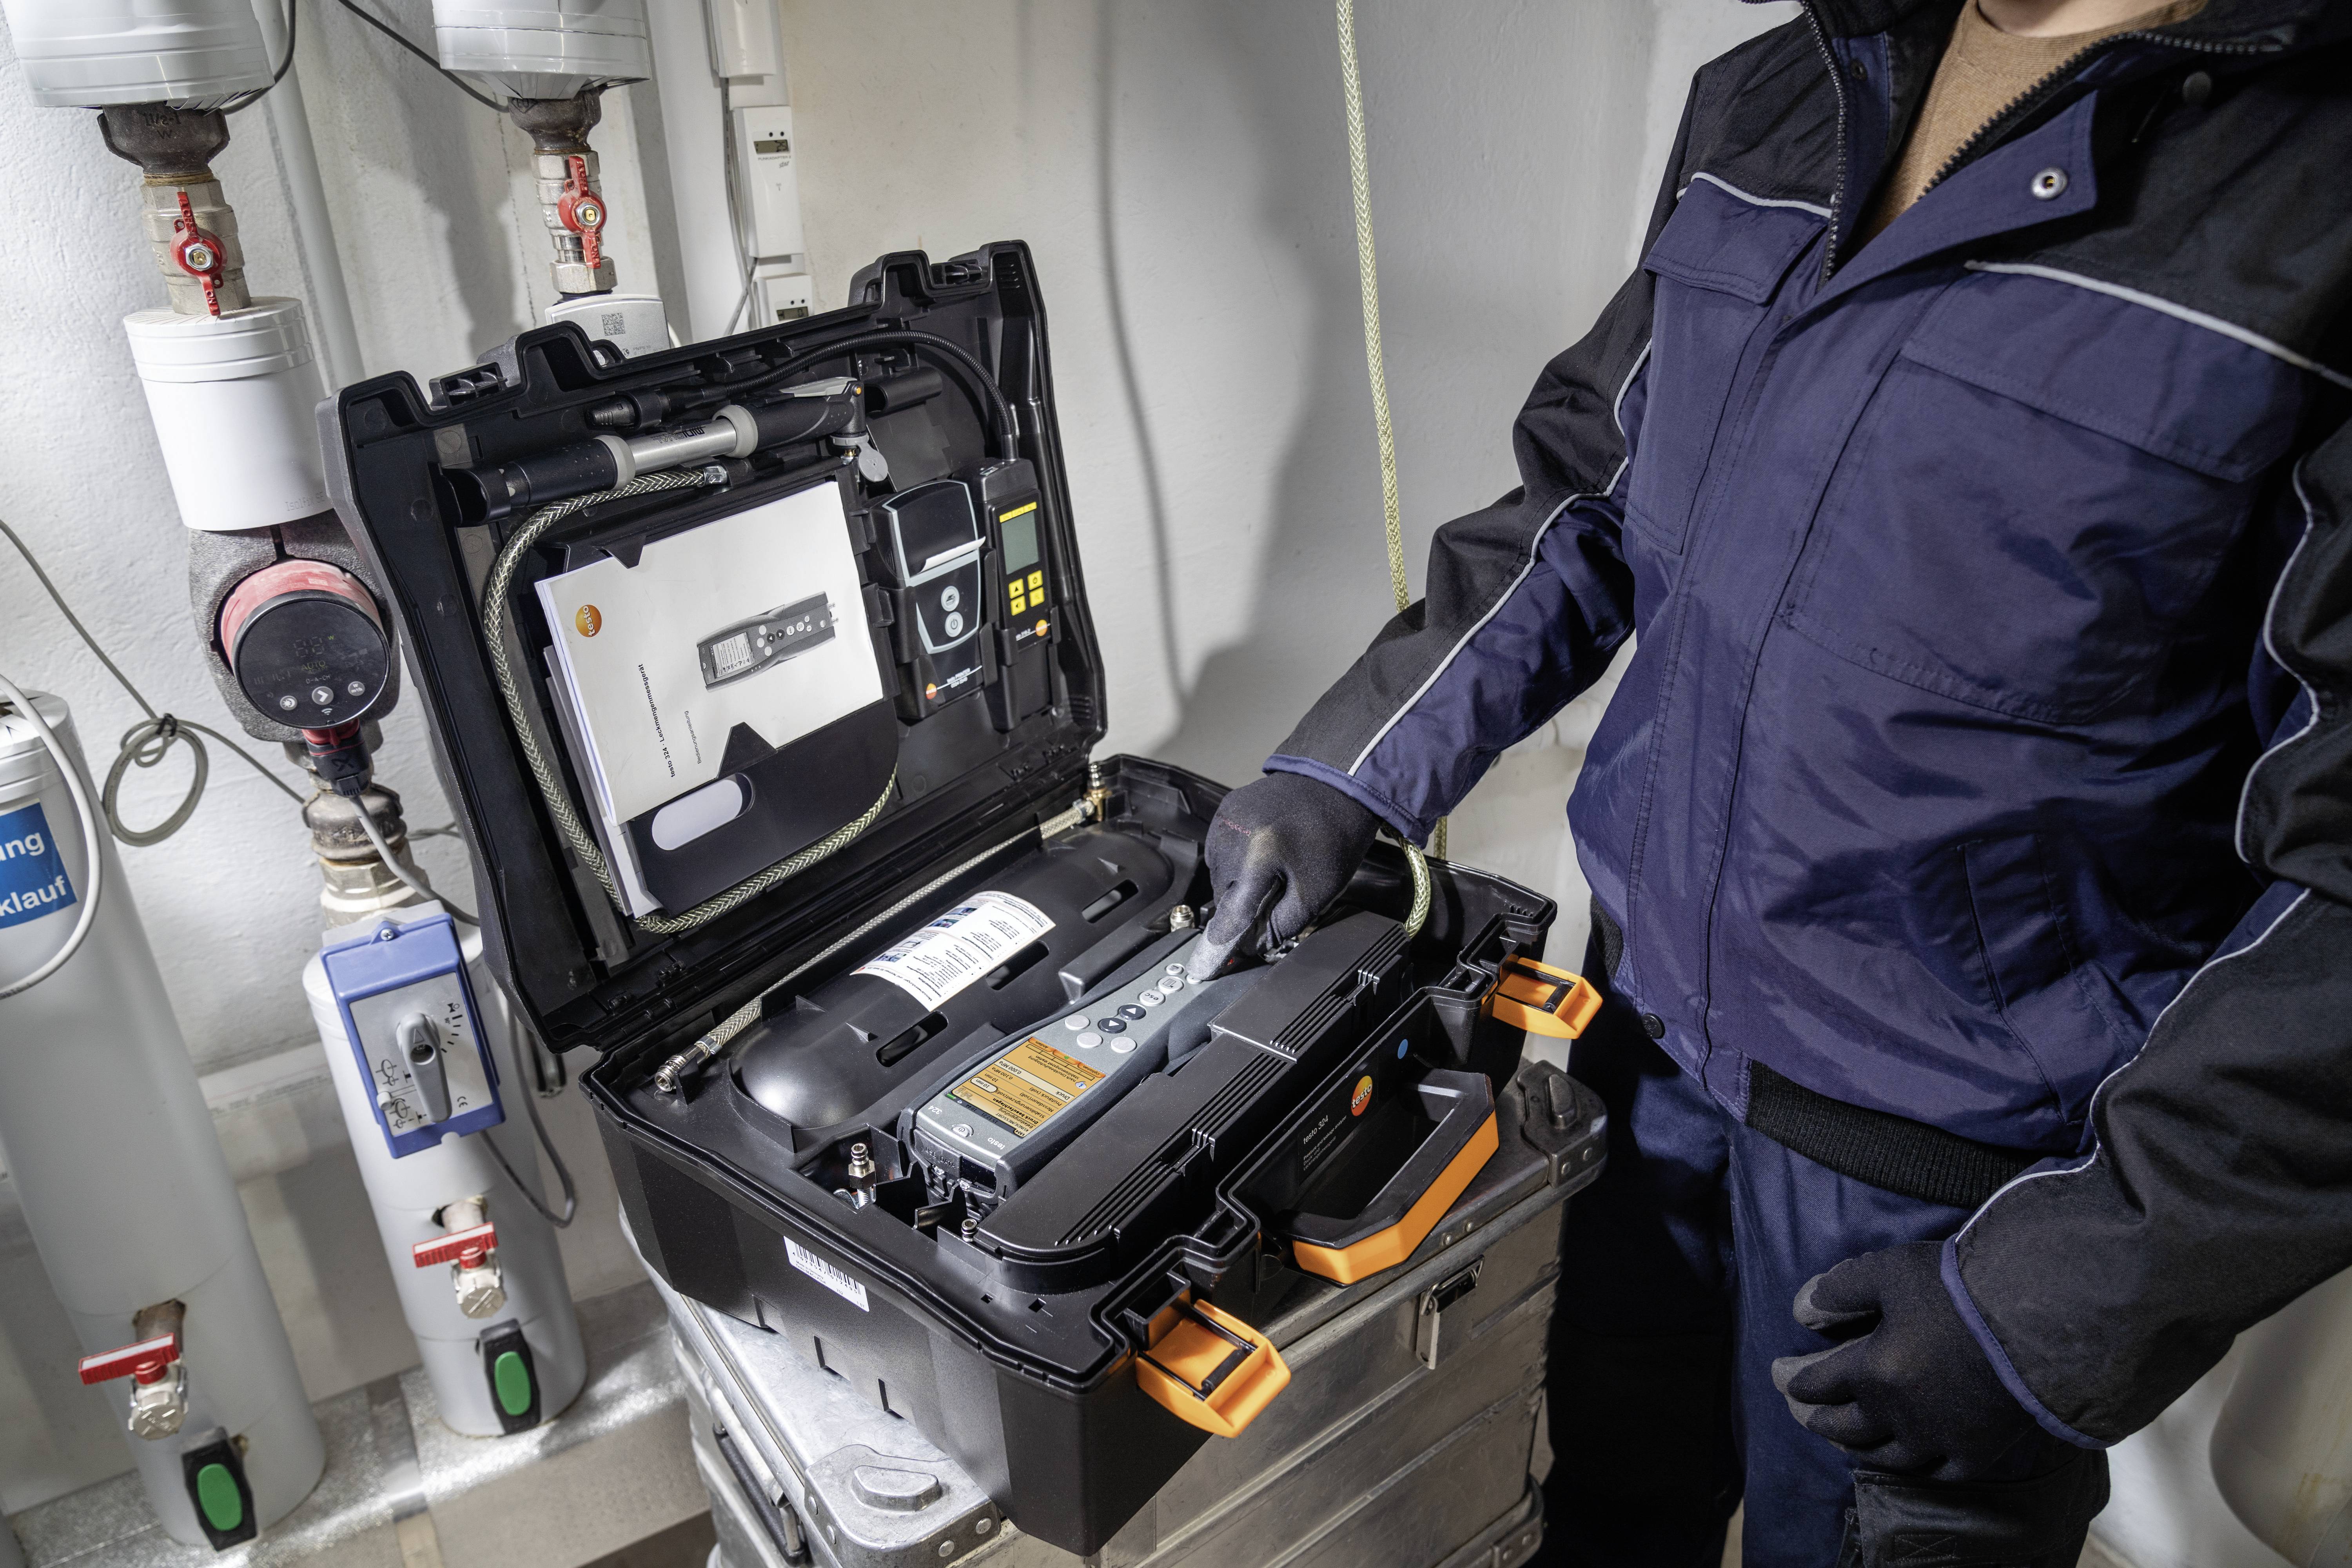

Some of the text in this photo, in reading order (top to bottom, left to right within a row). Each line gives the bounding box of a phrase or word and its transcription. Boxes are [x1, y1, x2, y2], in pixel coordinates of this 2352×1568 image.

[583, 606, 595, 636] testo
[638, 663, 665, 742] Leckmengenmessgerät
[684, 710, 702, 764] Bedienungsanleitung
[1007, 1065, 1022, 1074] 0,000
[1027, 1055, 1067, 1078] Druckbeaufschlagung
[1034, 1055, 1048, 1063] starten
[1082, 1065, 1100, 1076] Optionen
[1018, 1092, 1054, 1112] Messdauer(soll)
[1040, 1093, 1062, 1106] Prüfdruck
[1054, 1091, 1070, 1100] Druck
[1352, 1083, 1372, 1108] testo
[991, 1098, 1039, 1124] Druck beaufschlagen
[995, 1112, 1029, 1132] KUNDE/MESSORT
[997, 1107, 1034, 1129] Belastungsprüfung
[928, 1105, 1005, 1150] testo 324
[1303, 1115, 1328, 1144] testo 324
[940, 1156, 957, 1170] DATA
